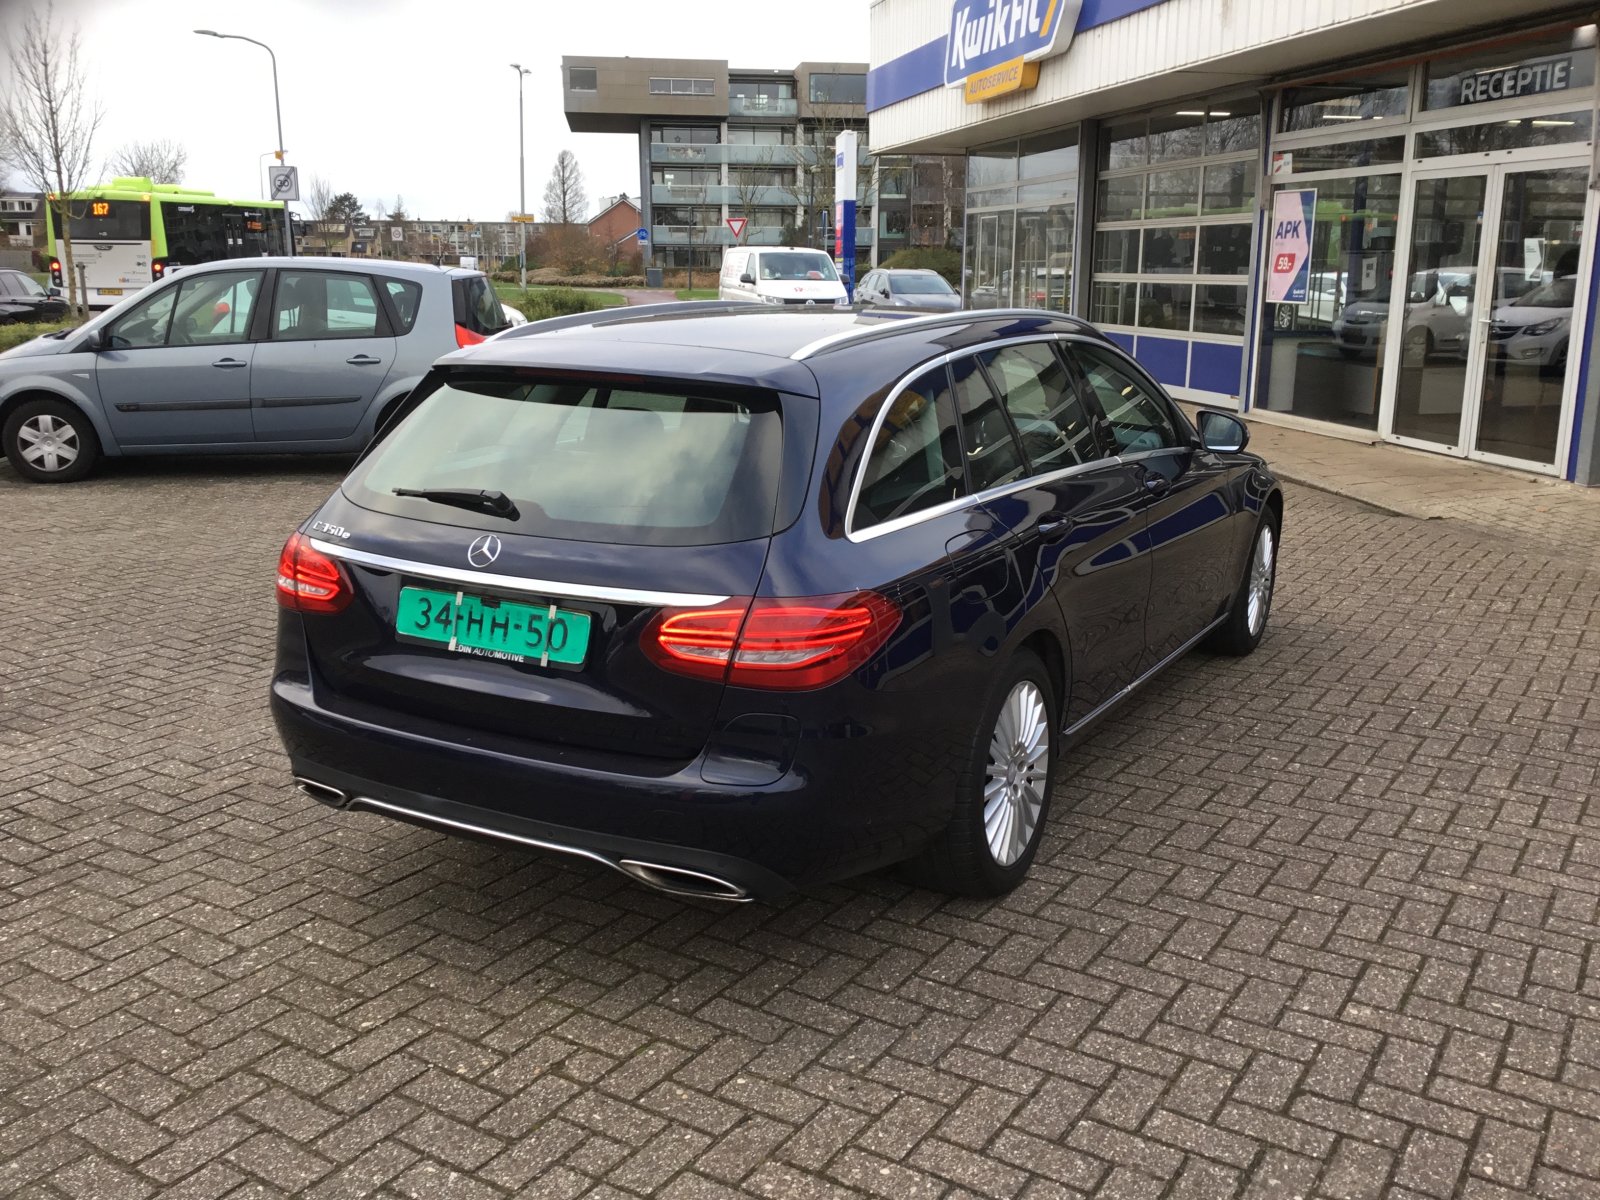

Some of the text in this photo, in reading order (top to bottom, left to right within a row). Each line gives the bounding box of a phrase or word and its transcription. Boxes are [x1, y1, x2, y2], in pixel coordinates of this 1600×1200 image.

[970, 65, 1018, 94] AUTOSERVICE
[1460, 61, 1568, 103] RECEPTIE
[277, 179, 289, 187] 30
[93, 203, 108, 215] 167
[1275, 220, 1301, 239] APK
[415, 597, 568, 652] 34-HH-50
[472, 646, 525, 663] AUTOMOTIVE
